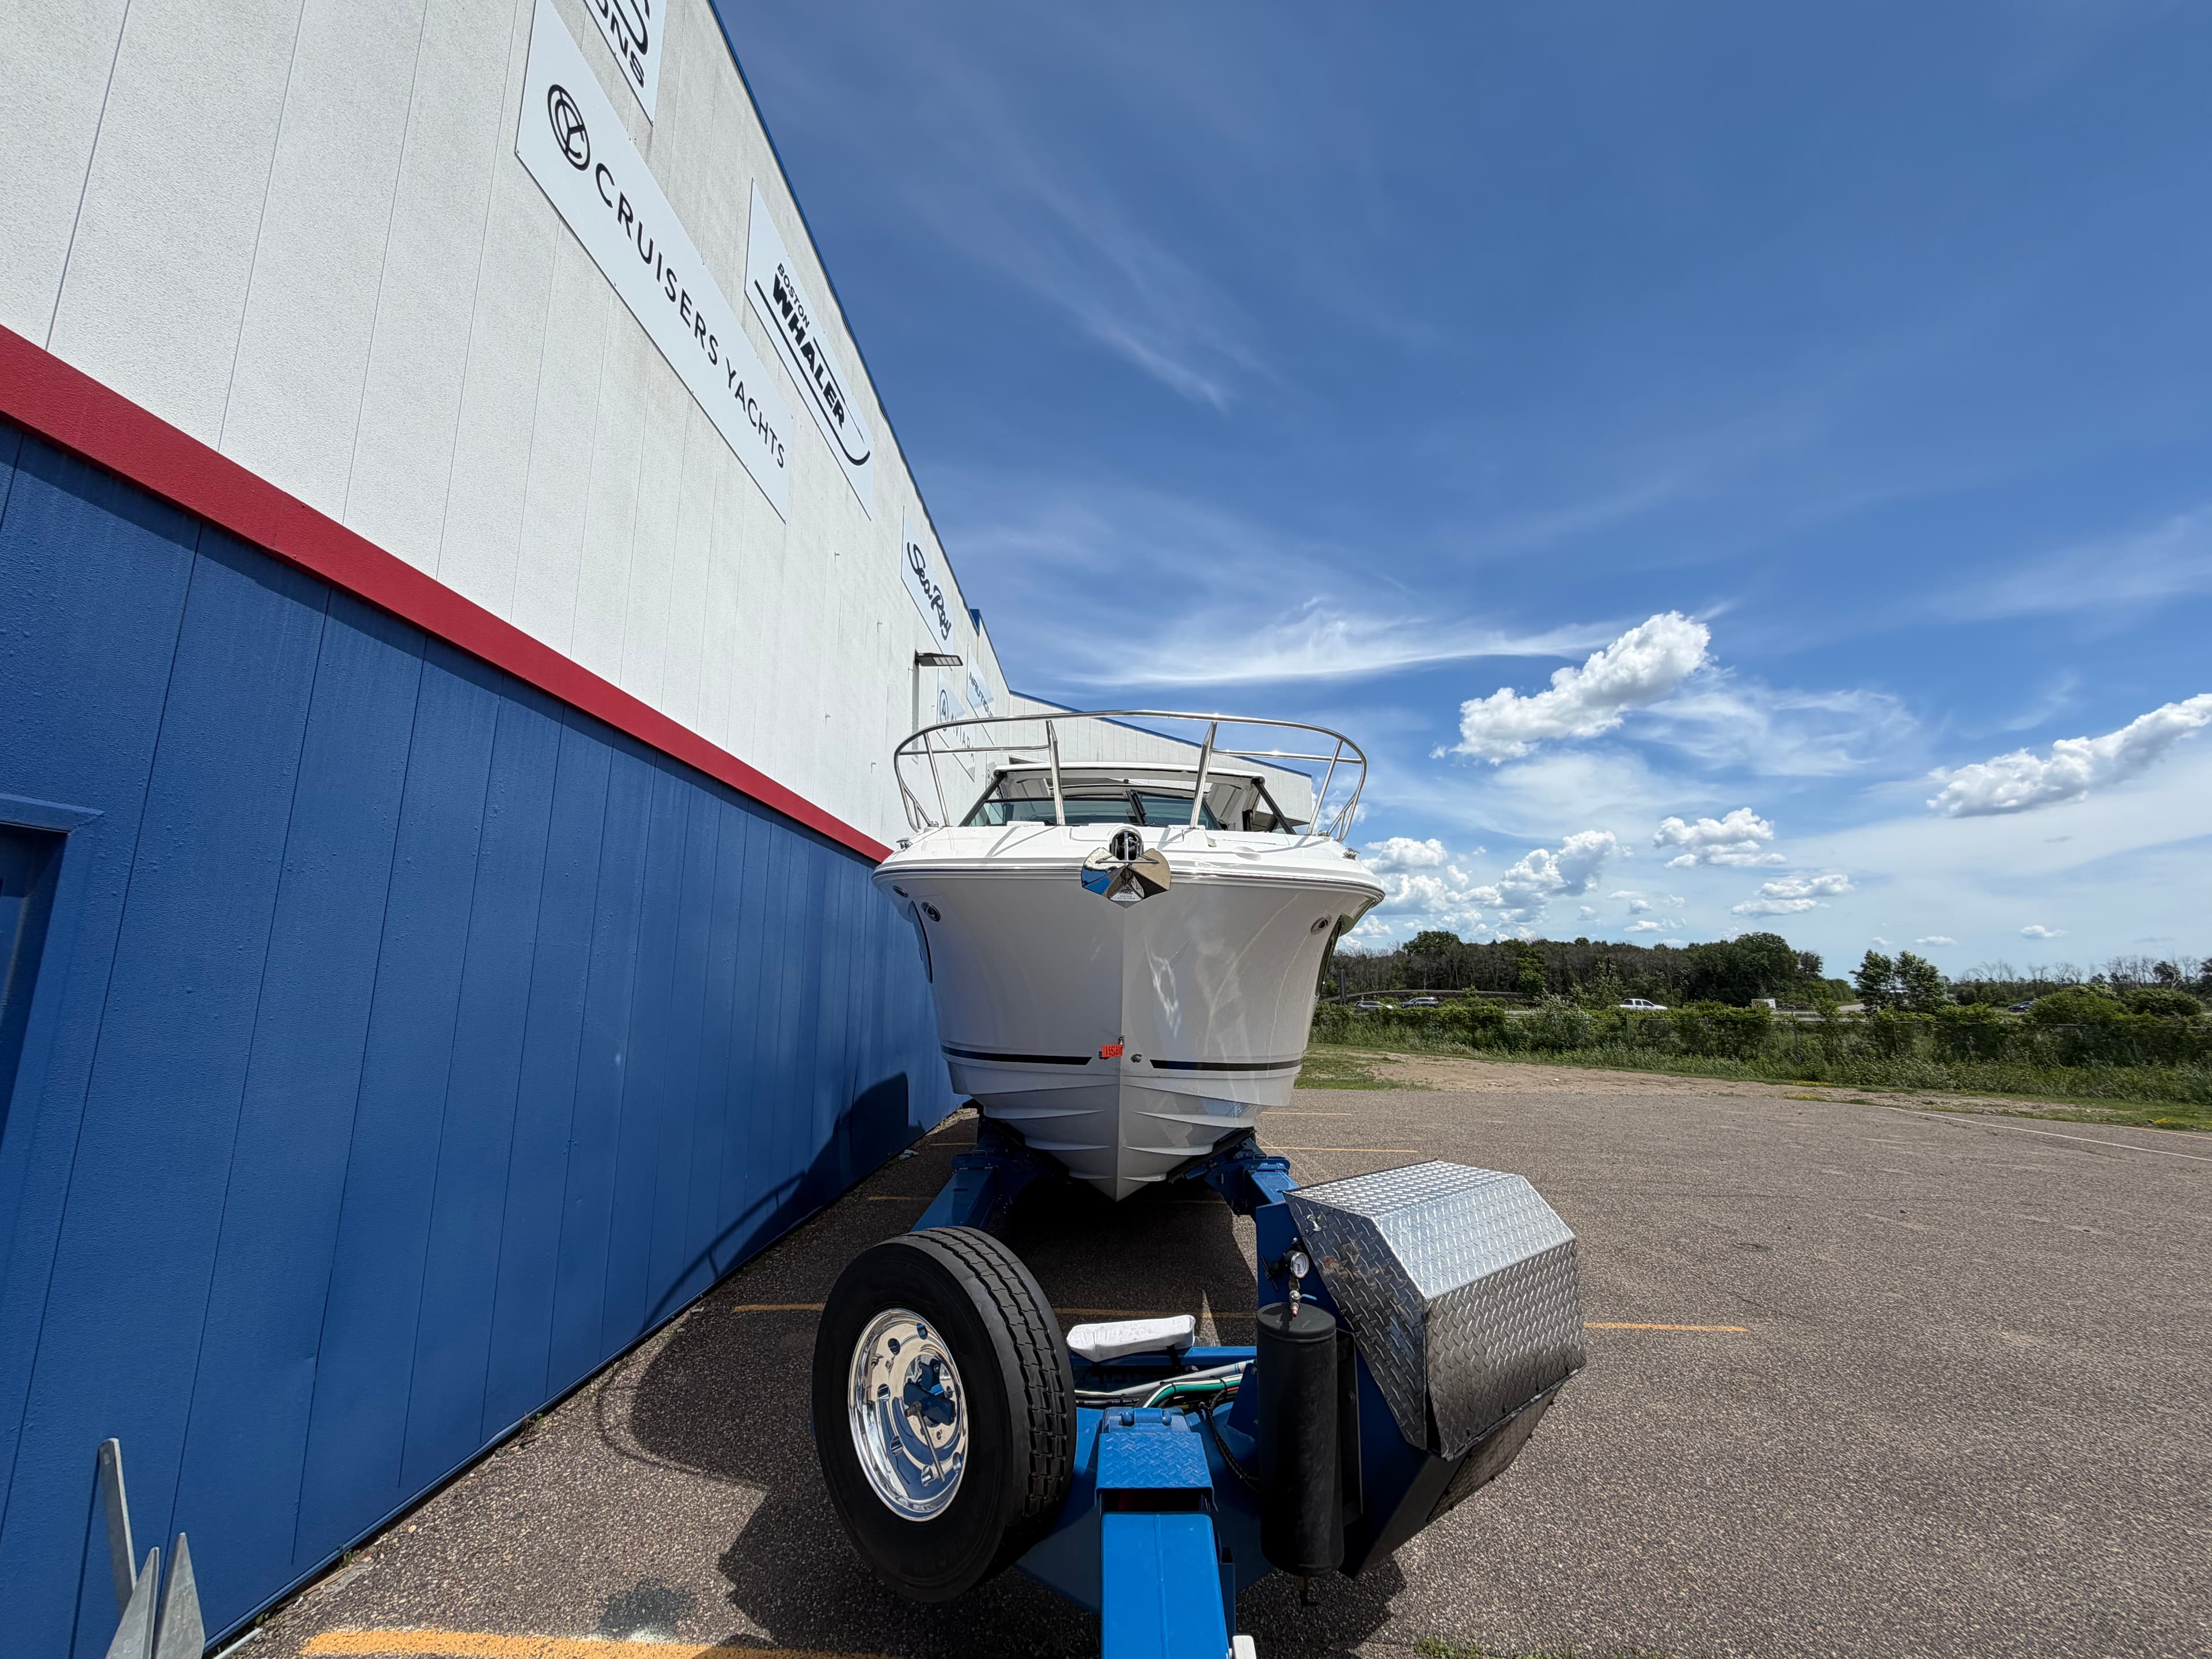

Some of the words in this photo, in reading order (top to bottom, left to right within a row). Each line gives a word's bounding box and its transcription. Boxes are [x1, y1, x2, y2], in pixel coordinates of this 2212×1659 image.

[595, 162, 719, 366] CRUISERS
[725, 357, 785, 469] YACHTS
[772, 272, 845, 430] WHALER
[777, 263, 810, 328] BOSTON
[907, 541, 933, 600] Sea
[930, 584, 952, 641] Ray
